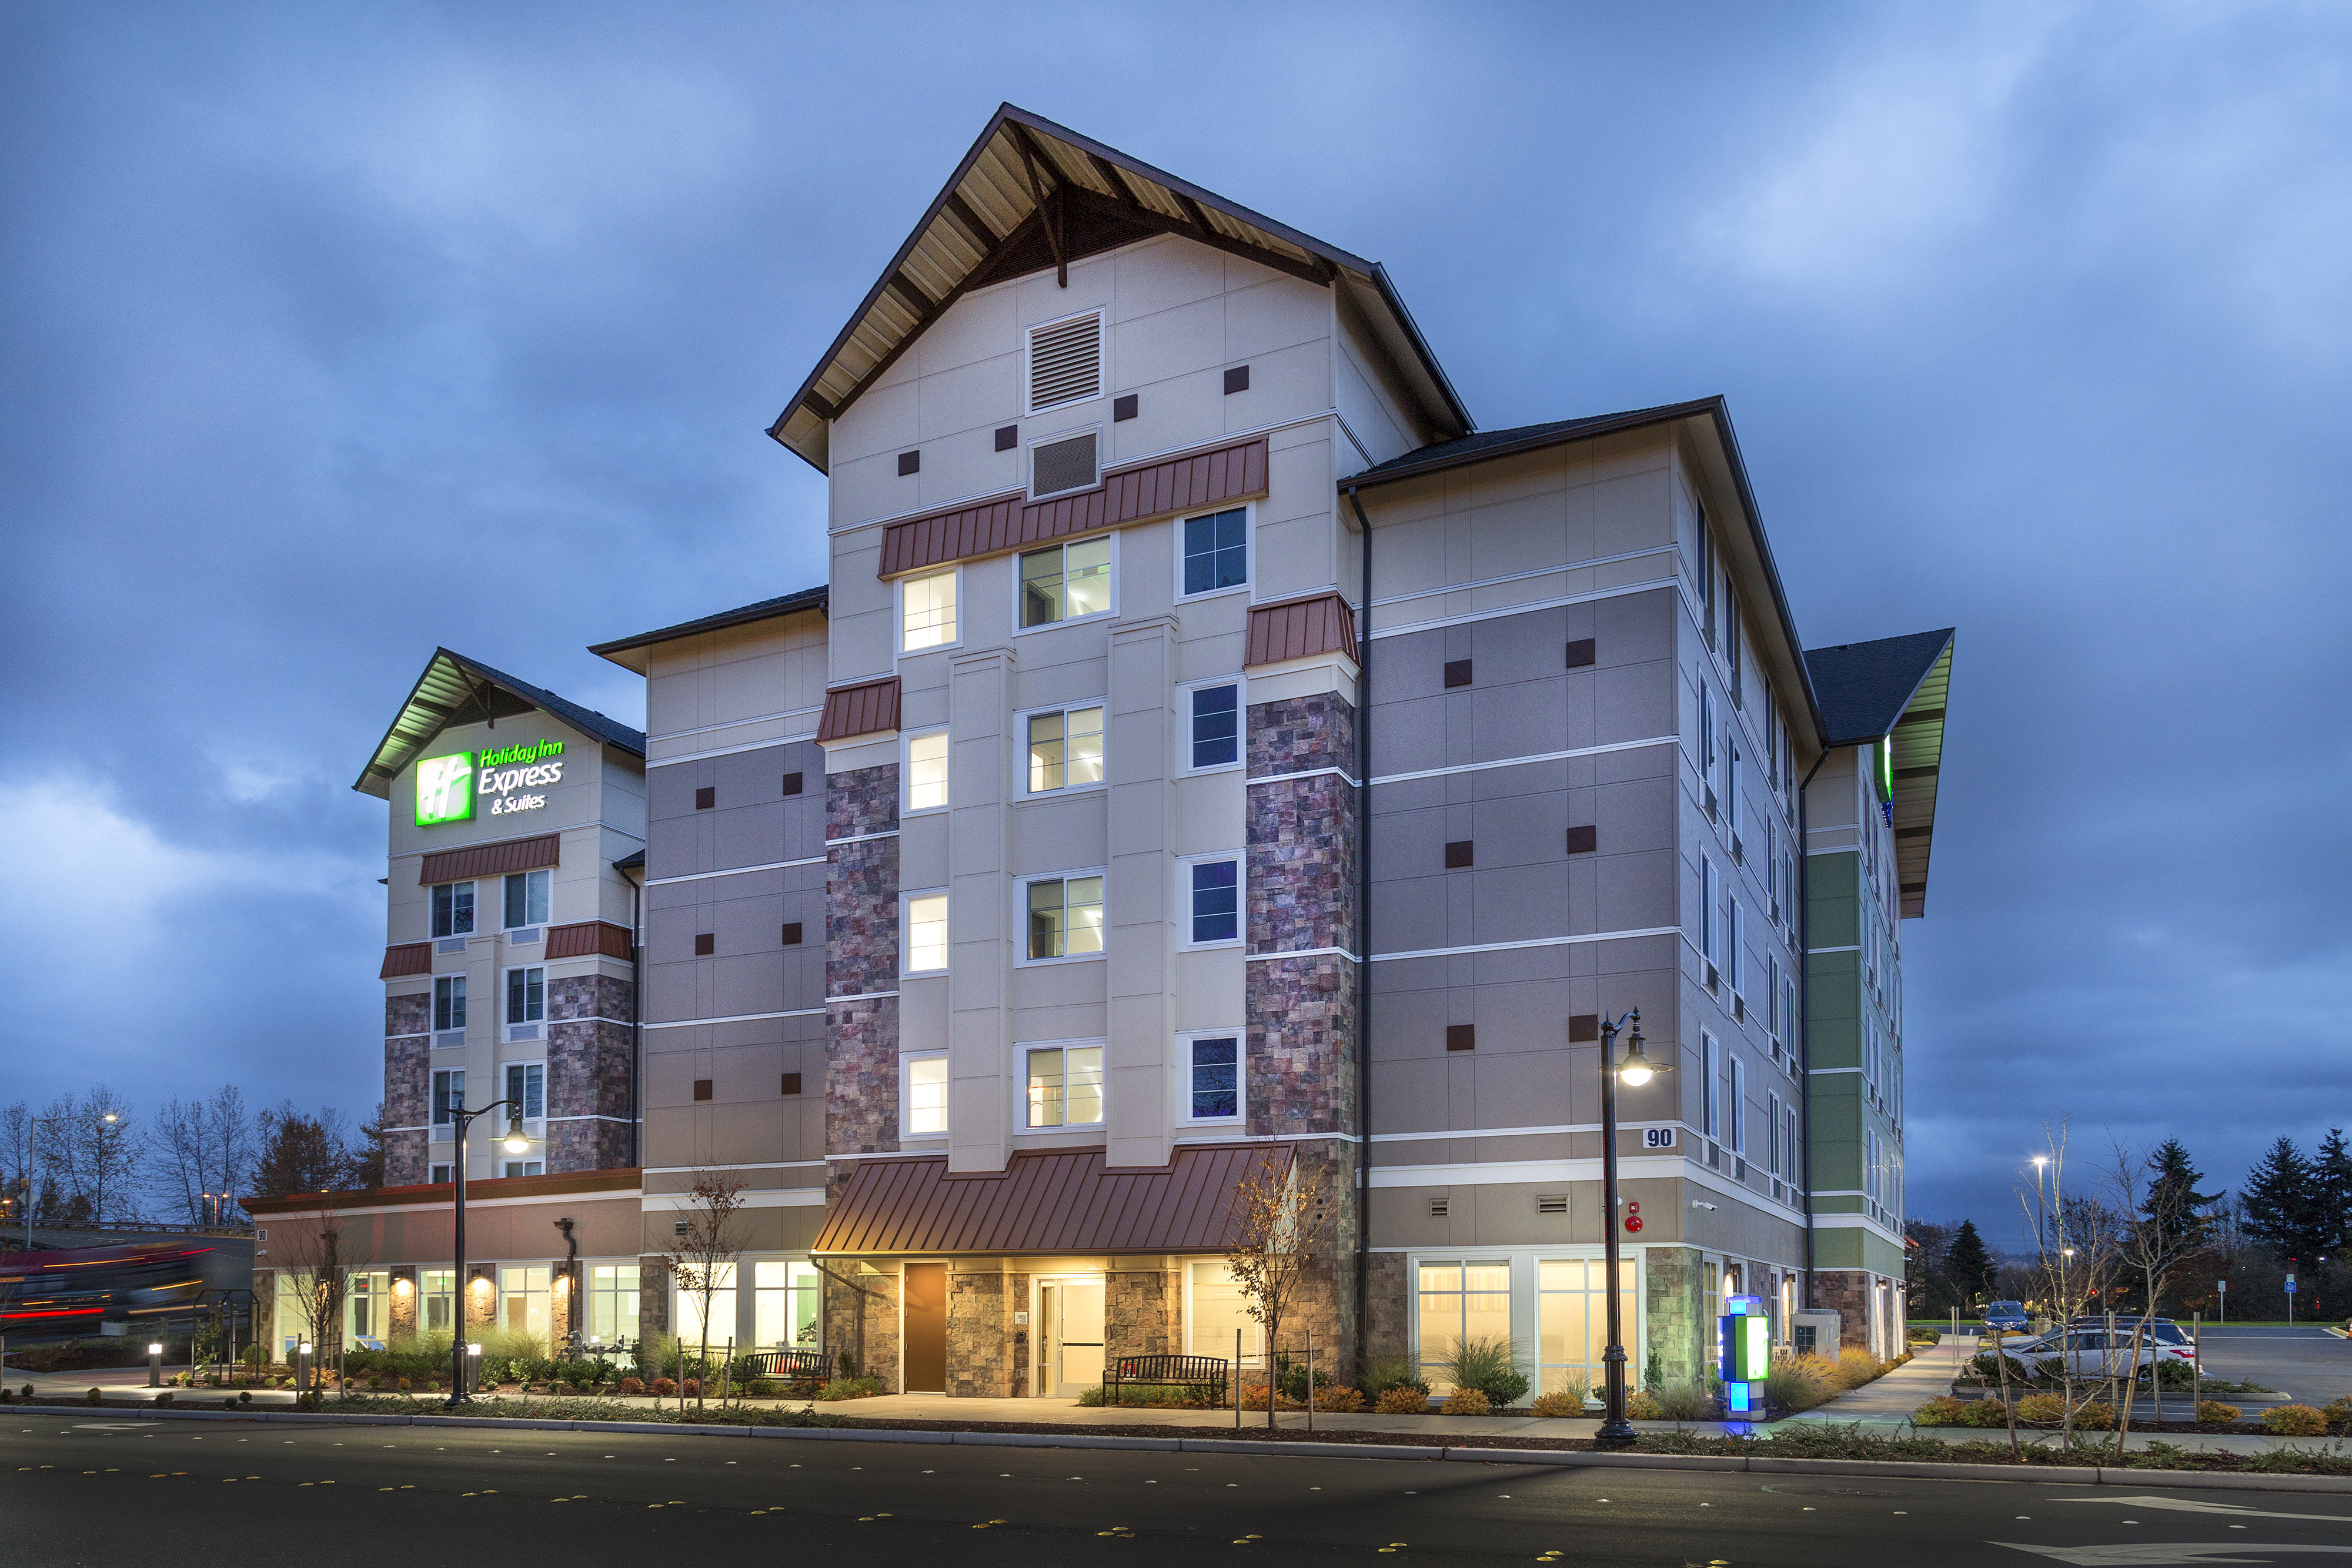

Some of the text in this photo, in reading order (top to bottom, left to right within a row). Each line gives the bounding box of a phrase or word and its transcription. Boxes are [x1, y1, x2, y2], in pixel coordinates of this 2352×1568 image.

[479, 738, 563, 767] Holiday Inn
[478, 762, 563, 797] Express
[491, 794, 546, 815] & Suites
[1648, 1129, 1672, 1147] 90
[259, 1230, 266, 1241] 90
